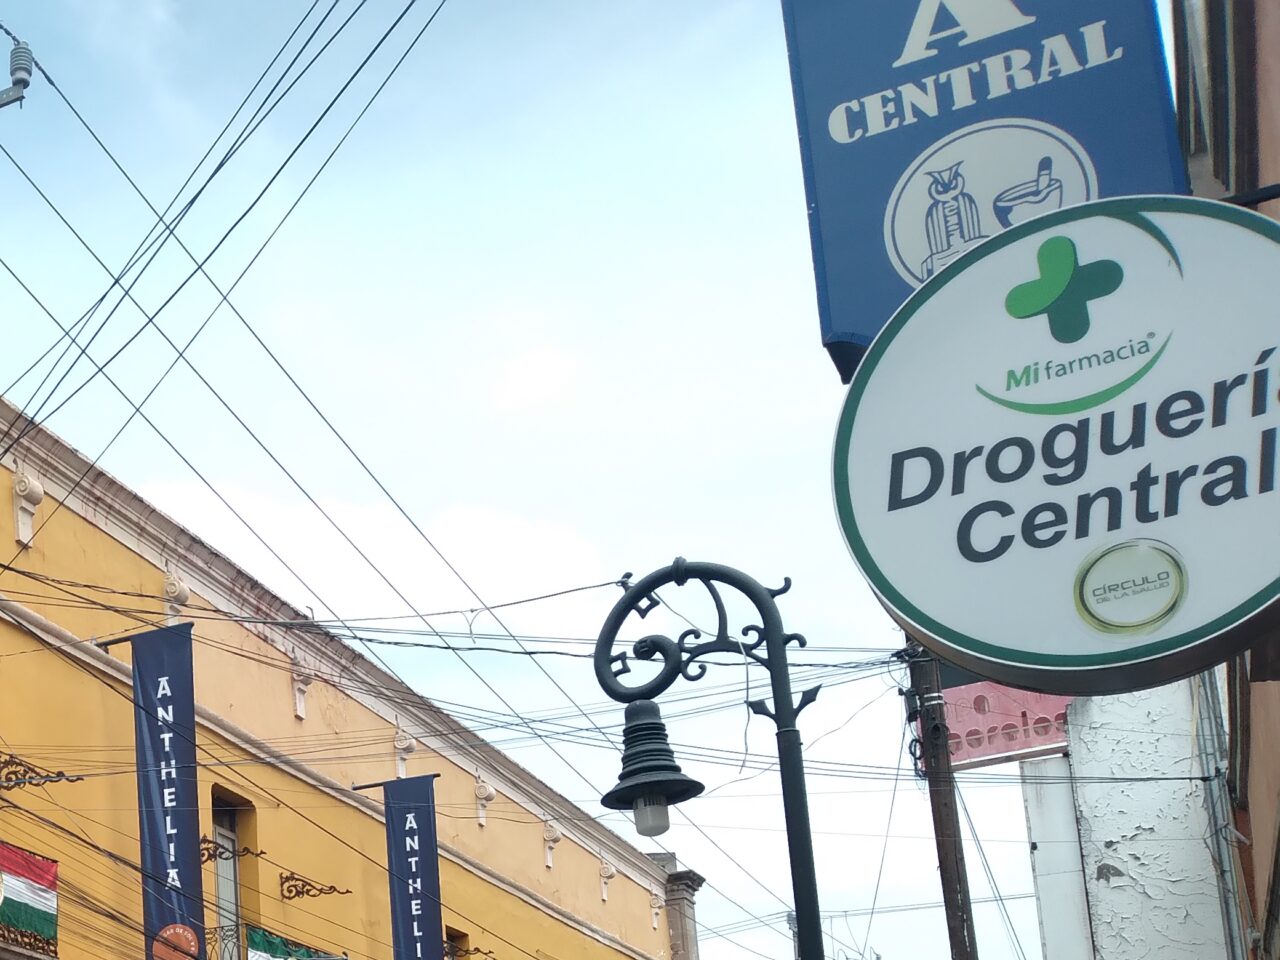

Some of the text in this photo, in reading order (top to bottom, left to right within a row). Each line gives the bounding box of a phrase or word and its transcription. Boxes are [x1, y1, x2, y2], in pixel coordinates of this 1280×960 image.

[827, 20, 1124, 144] CENTRAL
[886, 346, 1280, 513] Droguerí
[955, 427, 1277, 564] Central
[1091, 570, 1170, 598] CÍRCULO
[1095, 581, 1170, 605] DE LA SALUD
[157, 676, 182, 890] ANTHELIA
